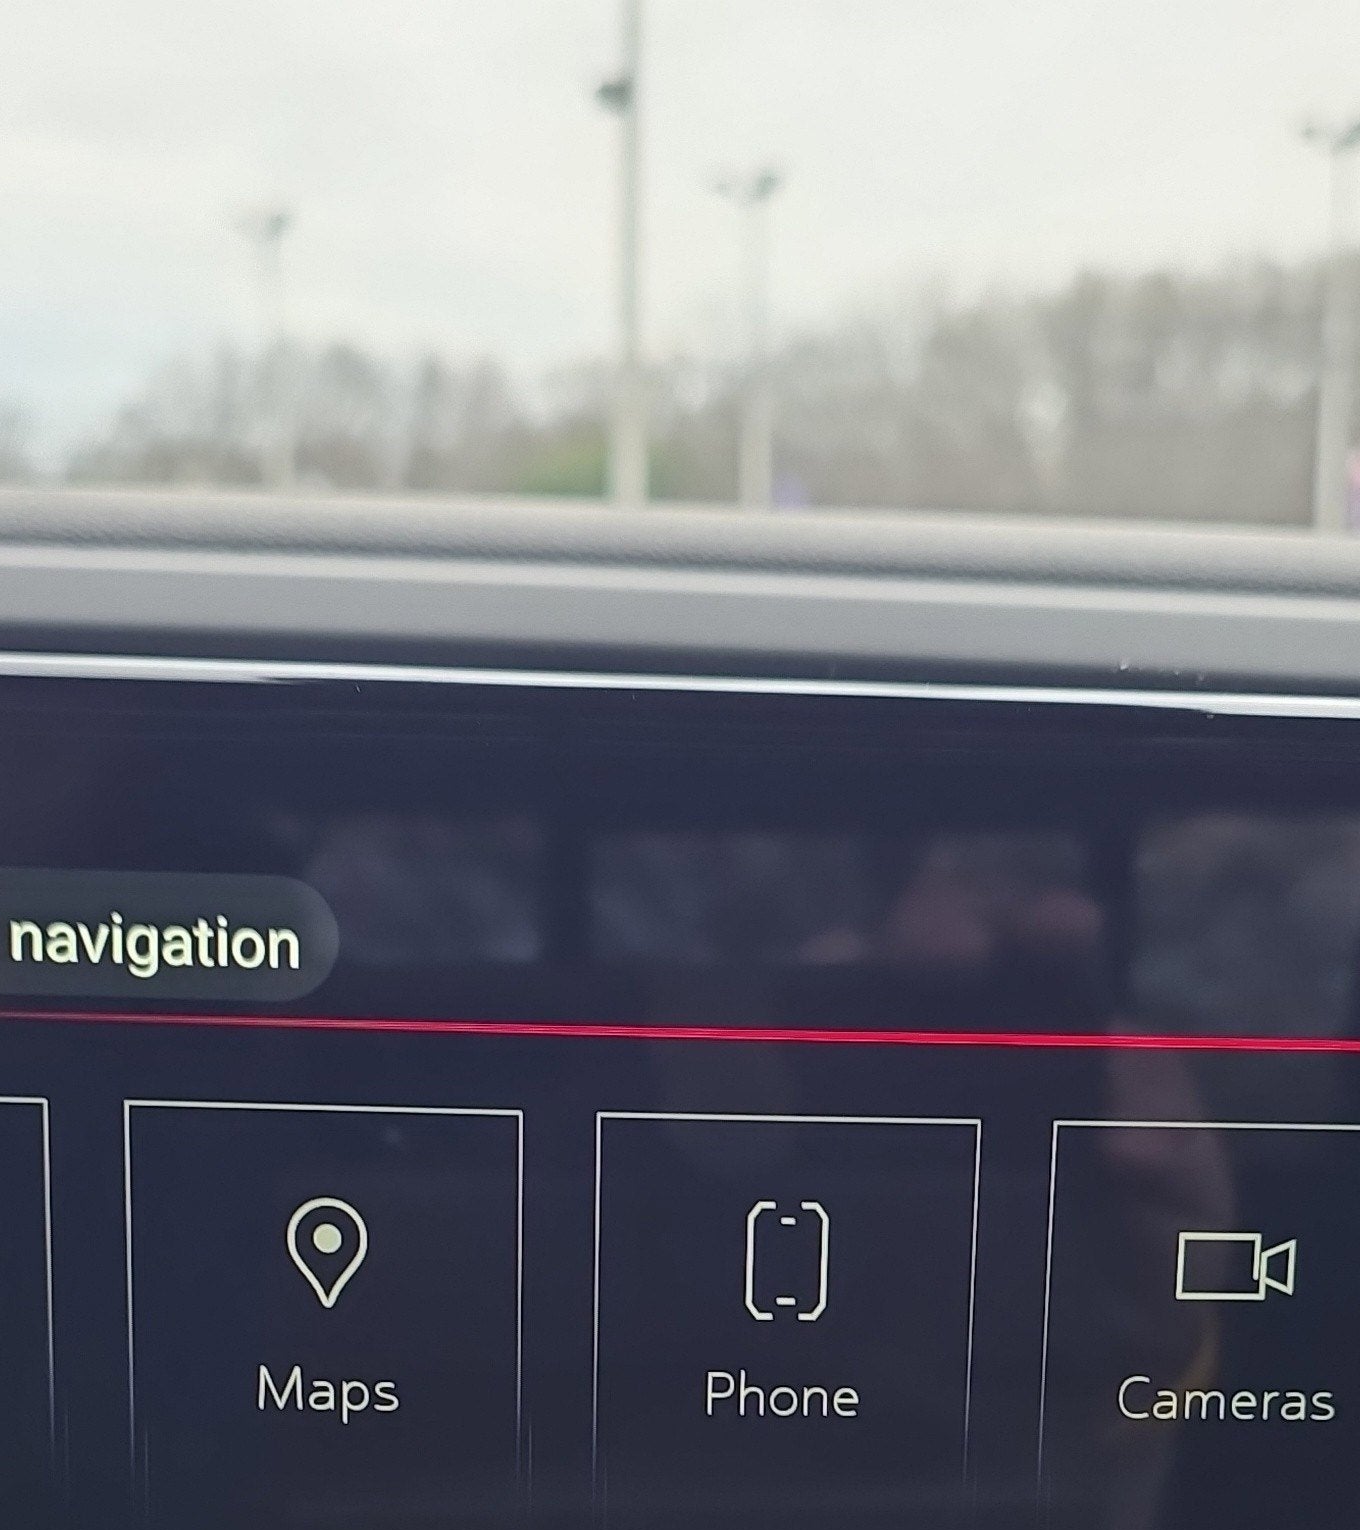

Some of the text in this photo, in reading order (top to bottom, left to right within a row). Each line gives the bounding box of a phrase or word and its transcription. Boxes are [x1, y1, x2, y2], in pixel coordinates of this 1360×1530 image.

[10, 910, 300, 978] navigation
[258, 1364, 399, 1425] Maps
[707, 1369, 859, 1417] Phone
[1118, 1375, 1335, 1421] Cameras
